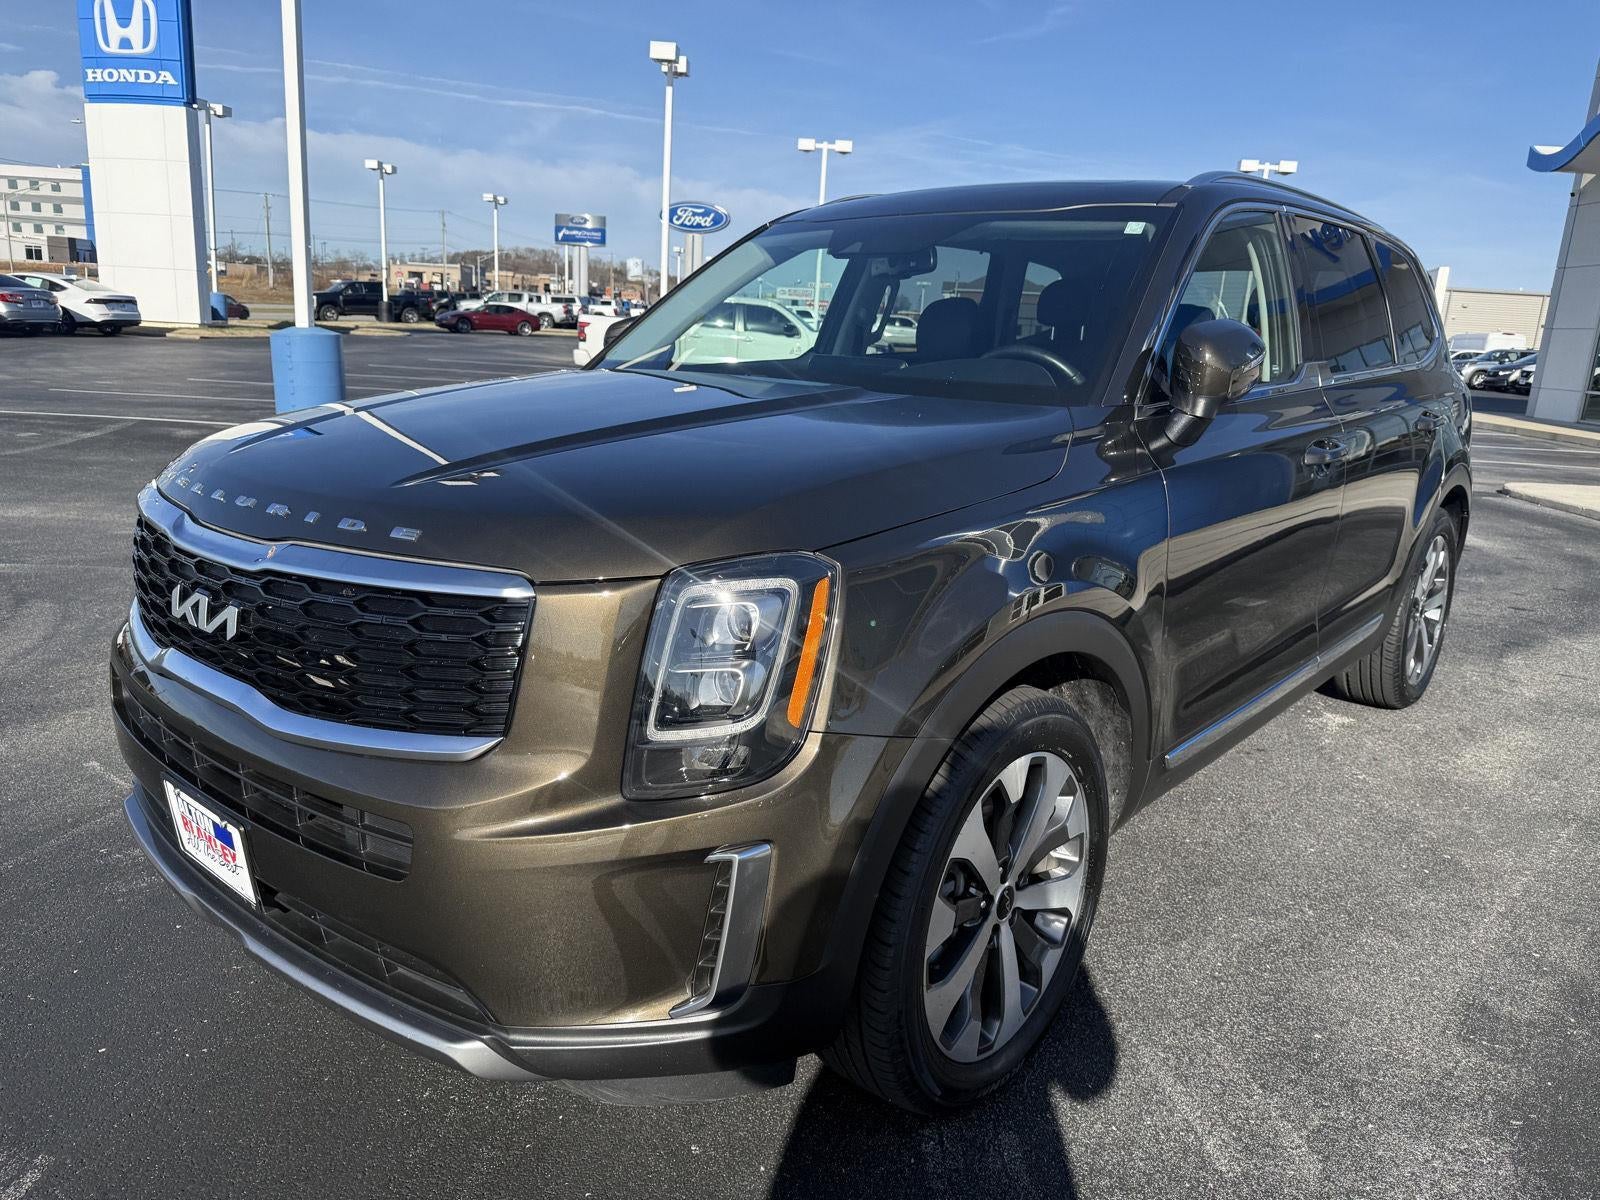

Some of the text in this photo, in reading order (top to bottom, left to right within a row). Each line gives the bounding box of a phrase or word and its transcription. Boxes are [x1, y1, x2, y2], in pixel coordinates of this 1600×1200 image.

[85, 68, 178, 85] HONDA
[673, 206, 714, 227] Ford
[171, 583, 240, 641] KIA
